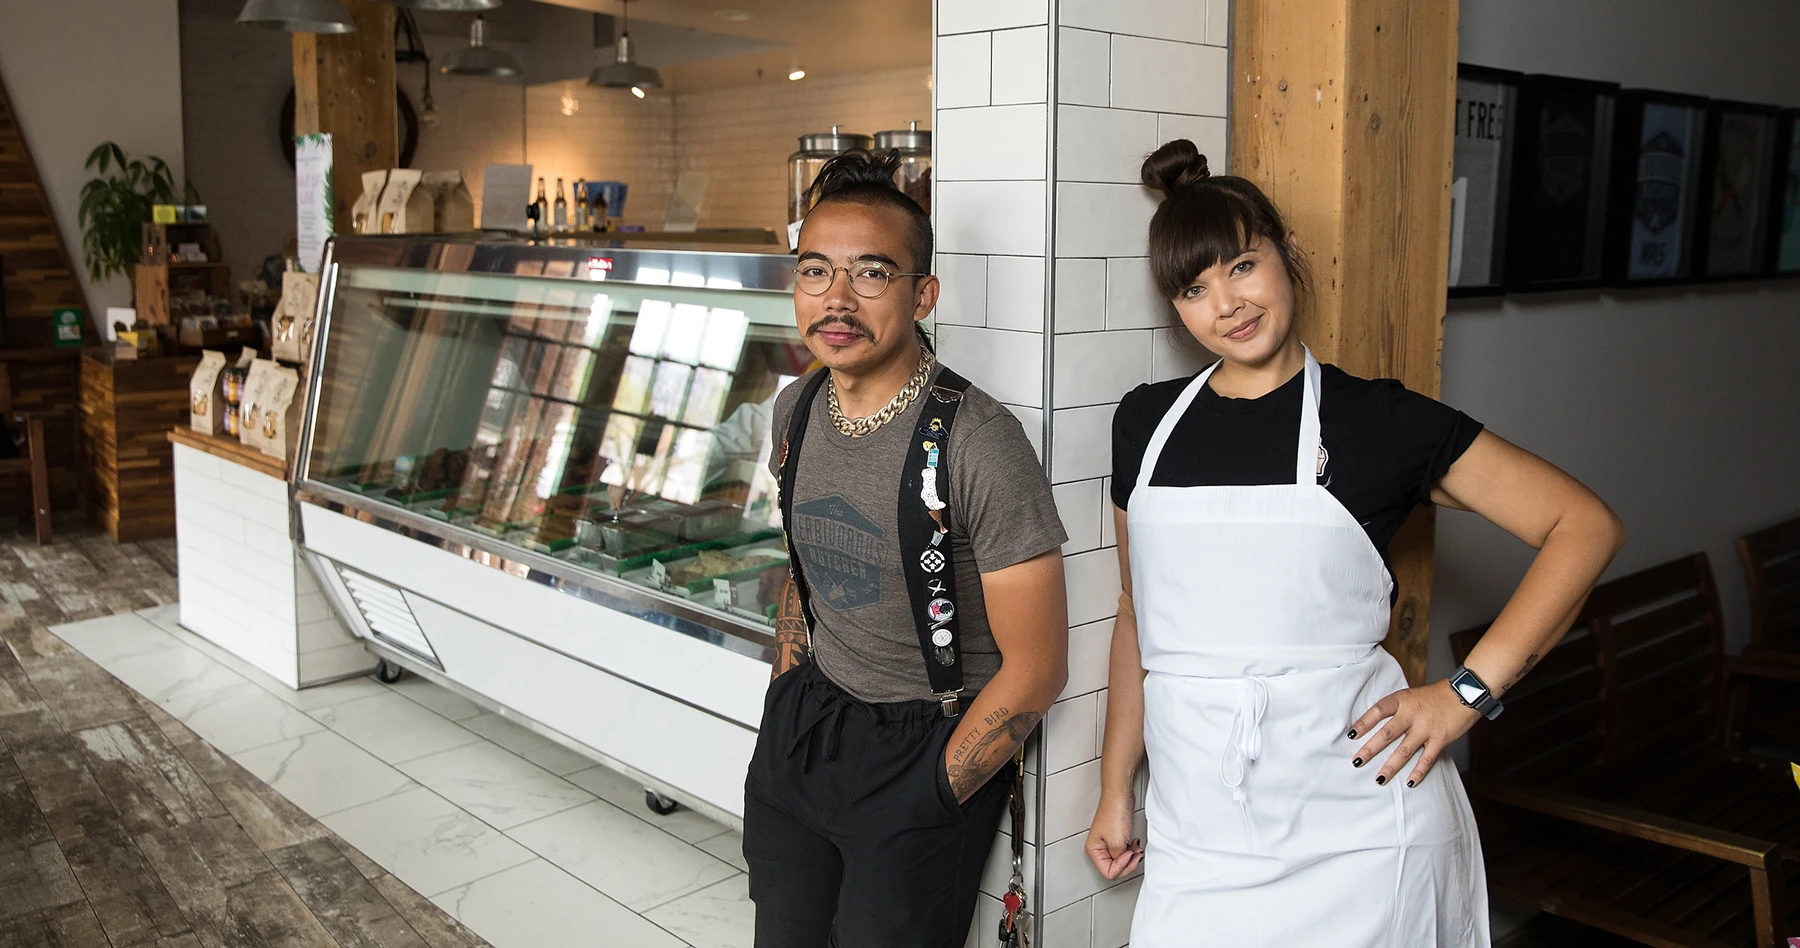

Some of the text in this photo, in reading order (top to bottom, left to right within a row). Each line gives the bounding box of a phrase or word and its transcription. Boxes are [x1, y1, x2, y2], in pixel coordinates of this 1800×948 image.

[810, 547, 866, 579] BUTCHER
[953, 707, 1009, 762] PRETTY BIRD
